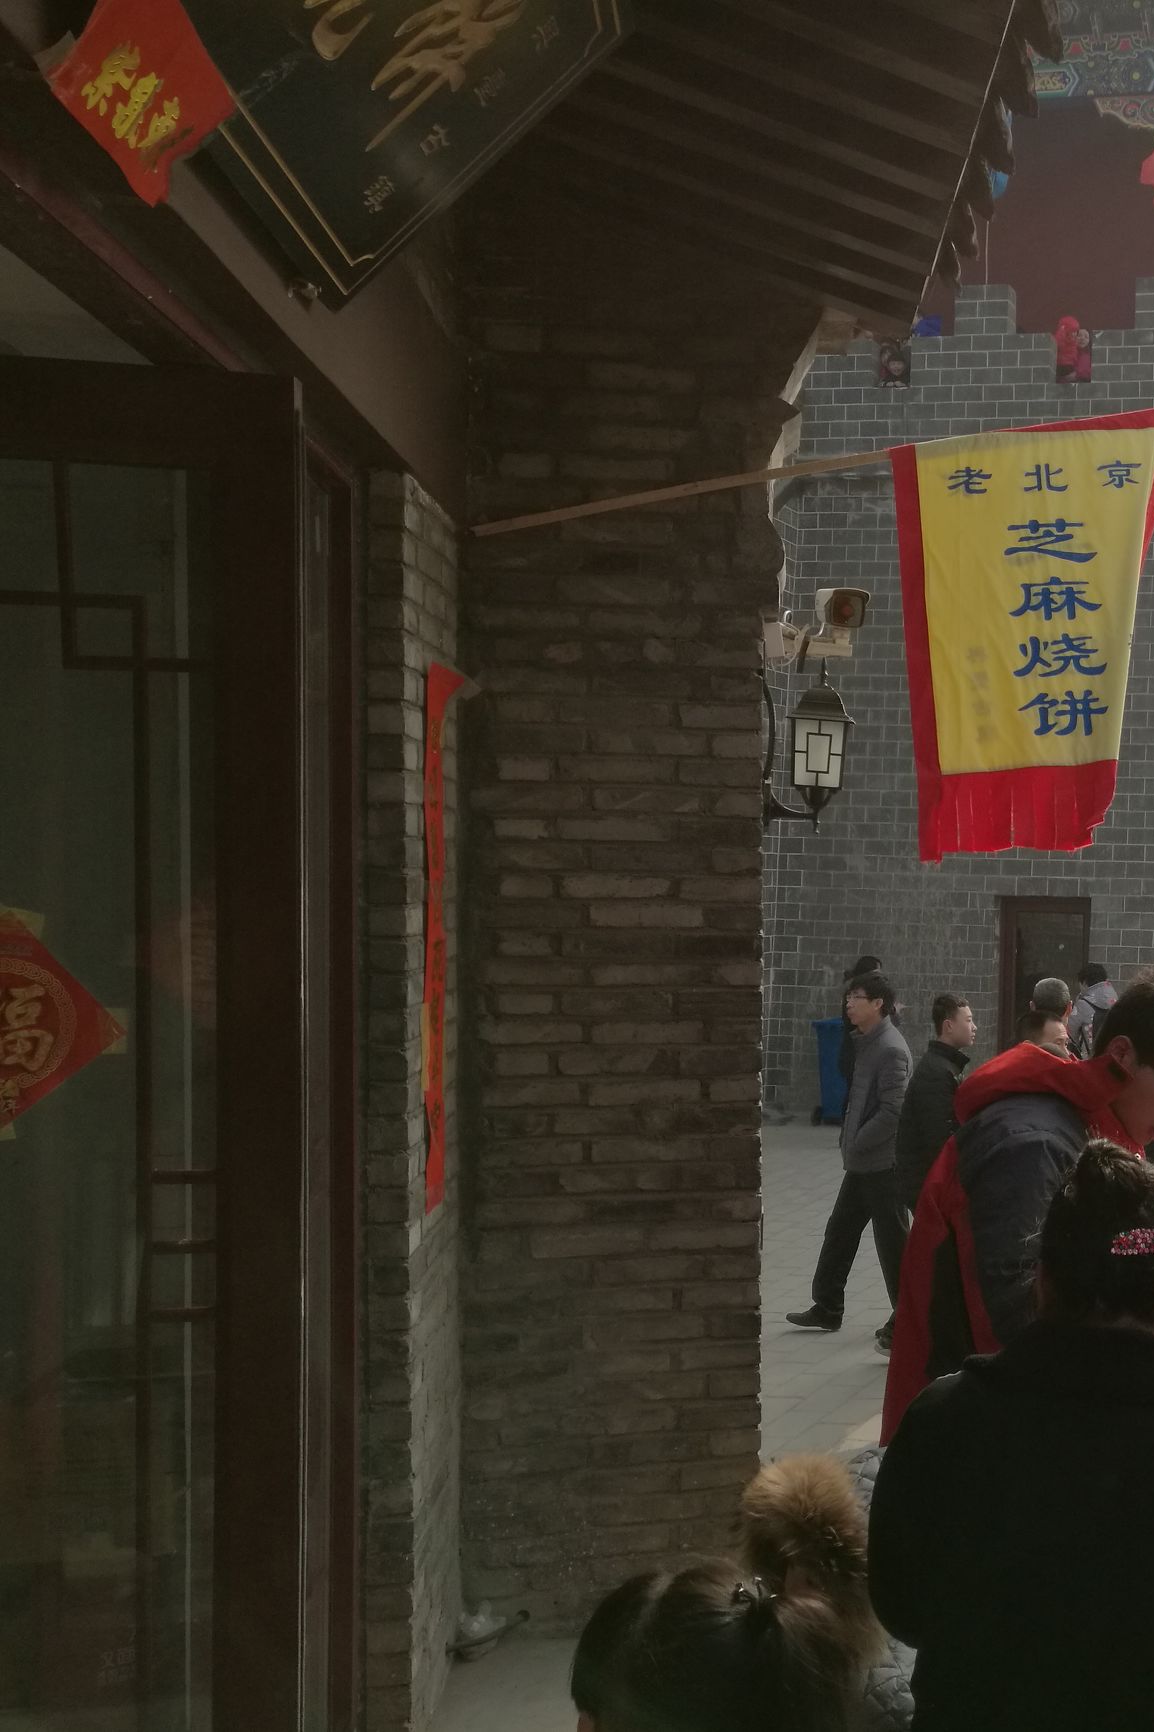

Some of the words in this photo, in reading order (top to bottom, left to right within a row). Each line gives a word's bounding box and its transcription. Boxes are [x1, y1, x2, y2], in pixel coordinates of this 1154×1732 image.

[946, 460, 1143, 495] 老北京
[1003, 518, 1108, 737] 芝麻烧饼
